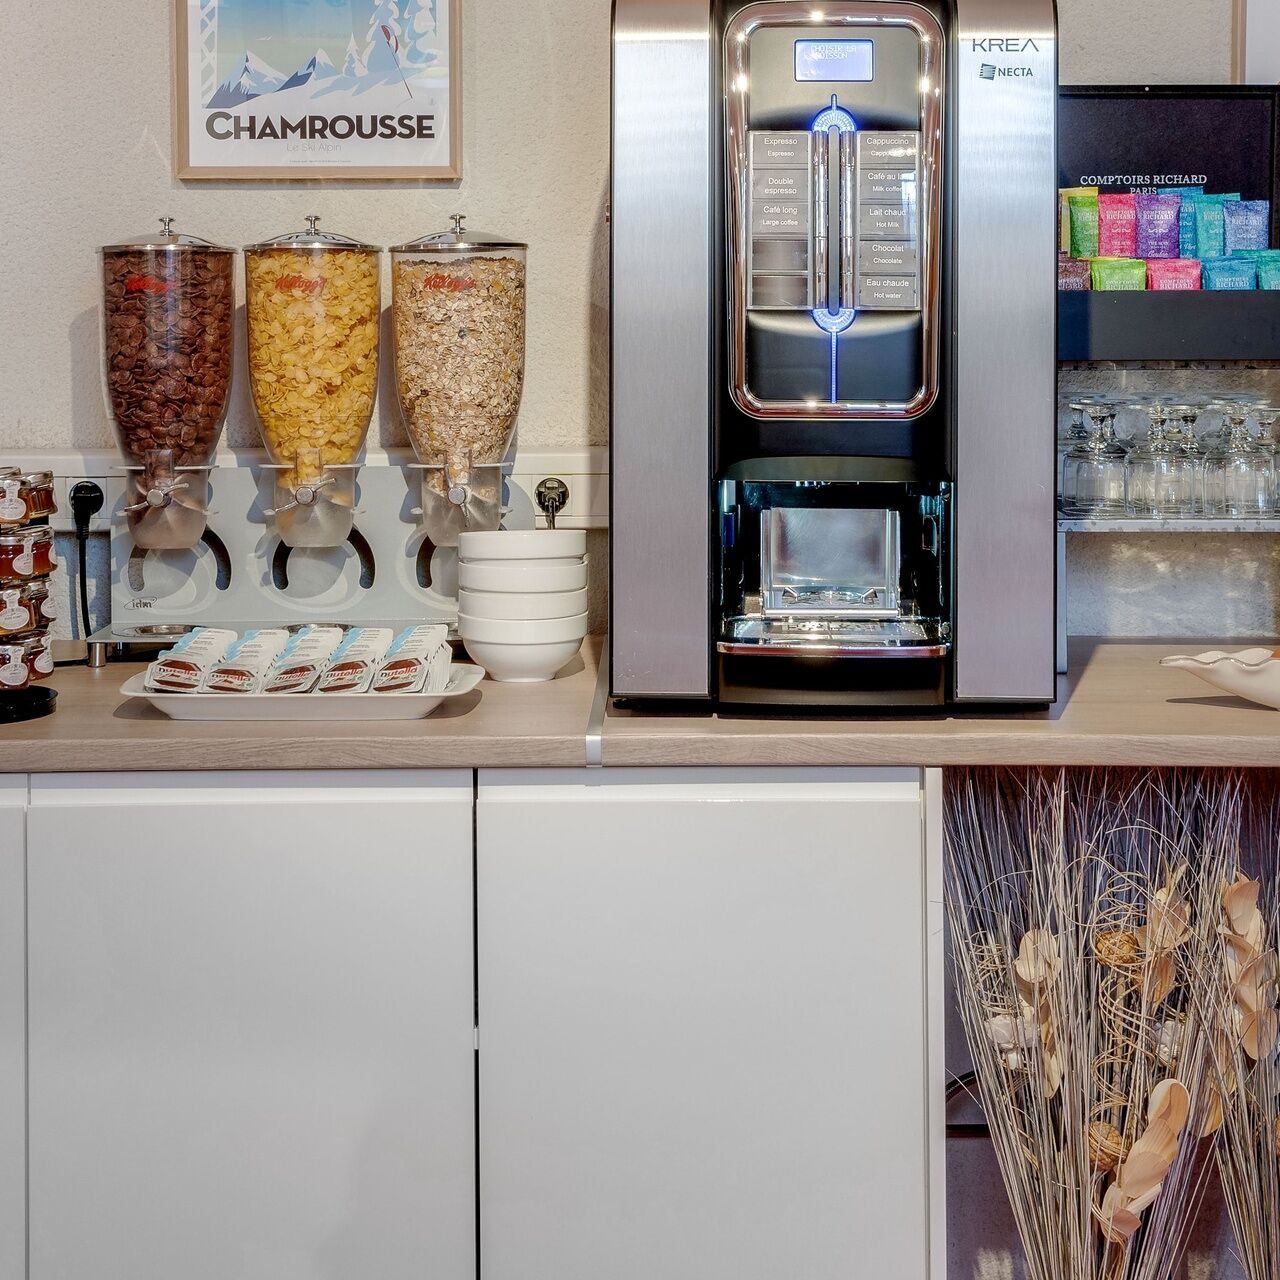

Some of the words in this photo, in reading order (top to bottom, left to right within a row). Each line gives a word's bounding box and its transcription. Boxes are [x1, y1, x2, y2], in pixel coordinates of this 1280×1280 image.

[973, 38, 1039, 52] KREA
[998, 67, 1034, 77] NECTA
[205, 111, 435, 140] CHAMROUSSE
[764, 138, 798, 146] Expresso
[866, 137, 909, 146] Cappuccino
[867, 172, 885, 180] Café
[1080, 175, 1150, 185] COMPTOIRS
[1152, 174, 1208, 185] RICHARD
[768, 177, 794, 185] Double
[1130, 187, 1158, 195] PARIS
[763, 205, 781, 214] Café
[782, 205, 798, 215] long
[869, 208, 883, 216] Lait
[872, 244, 904, 252] Chocolat
[866, 278, 881, 286] Eau
[882, 278, 910, 287] chaude
[158, 667, 198, 677] nutella
[326, 668, 363, 678] nutella
[380, 667, 418, 677] nutella
[211, 673, 251, 681] nutella
